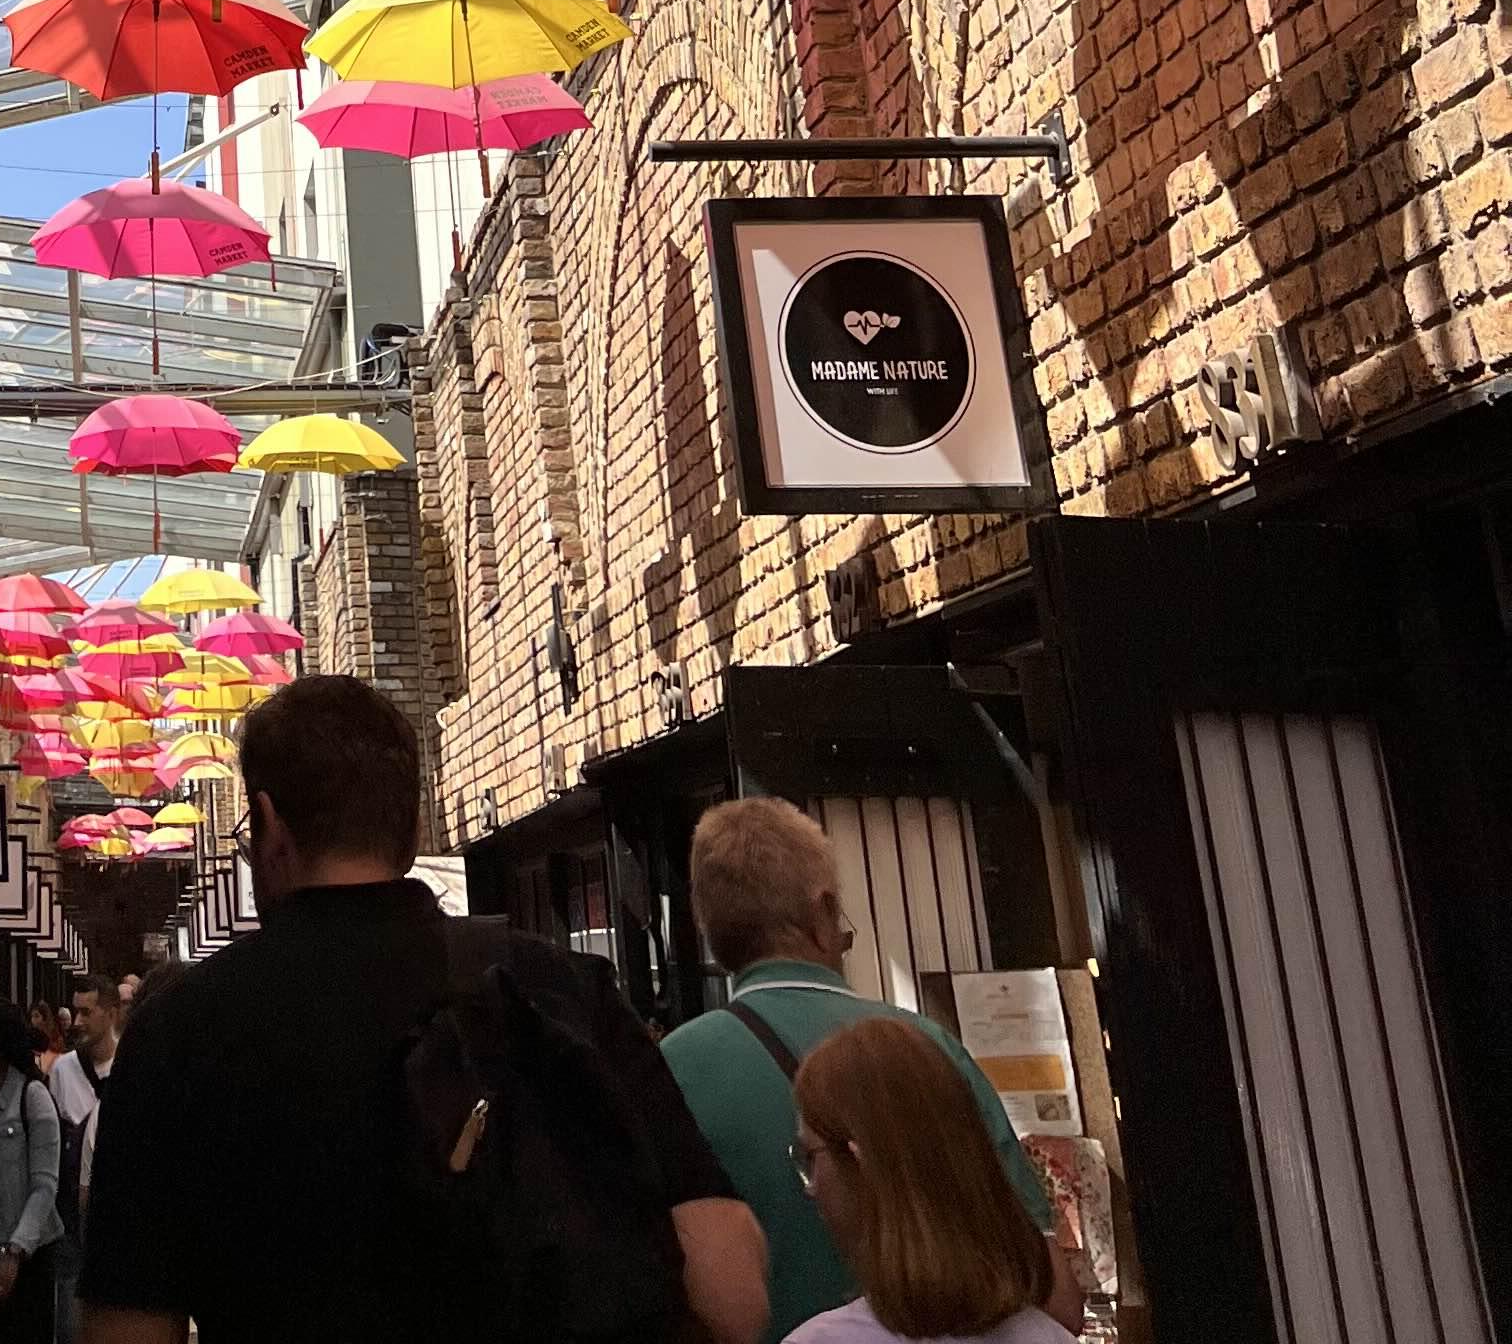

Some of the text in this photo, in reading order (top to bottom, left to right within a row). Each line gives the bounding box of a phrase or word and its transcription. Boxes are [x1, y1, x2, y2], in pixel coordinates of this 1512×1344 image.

[223, 44, 270, 68] CAMDEN
[230, 55, 276, 79] MARKET
[811, 359, 948, 381] MADAME NATURE
